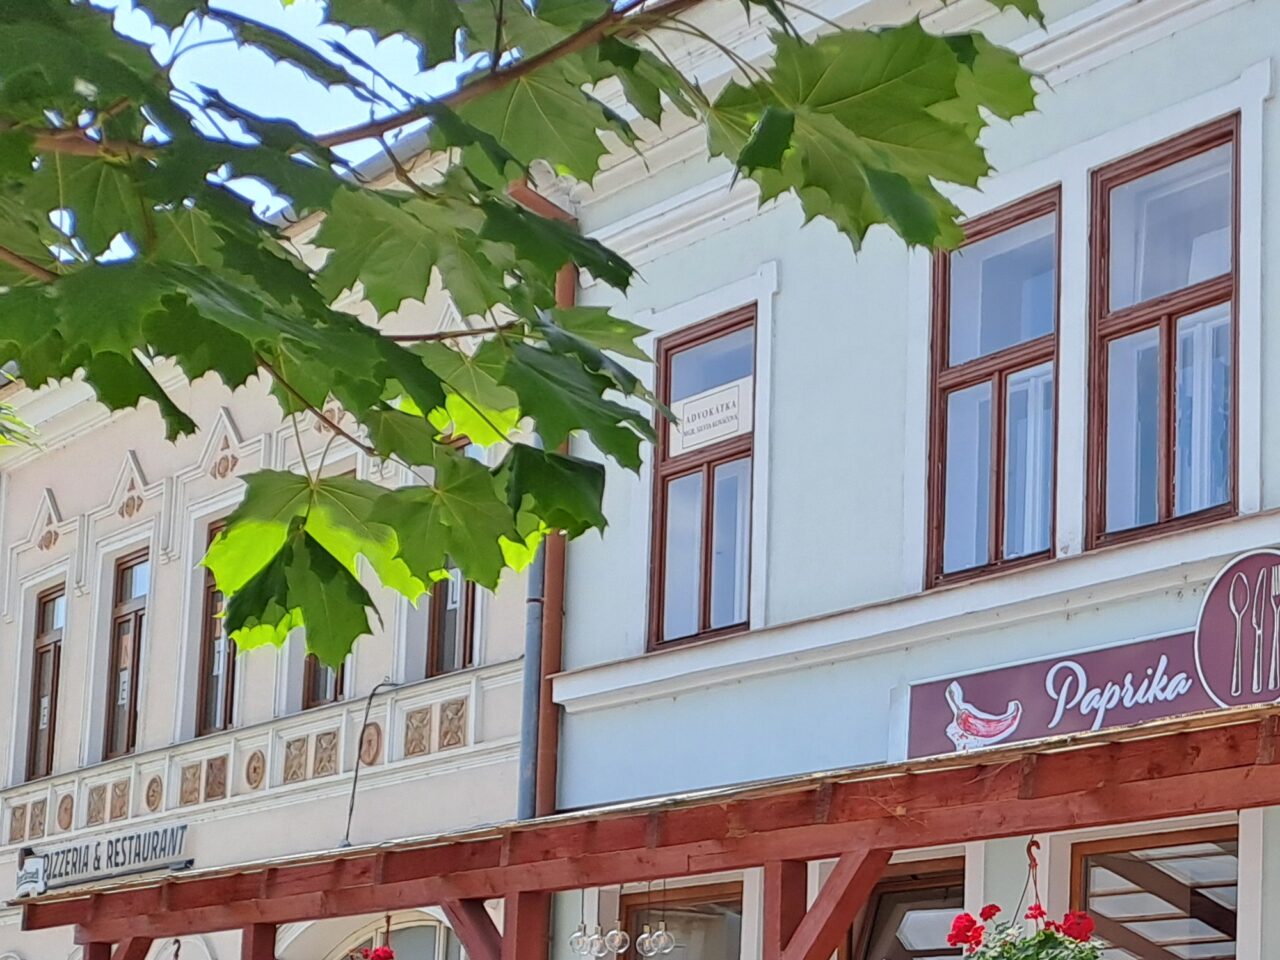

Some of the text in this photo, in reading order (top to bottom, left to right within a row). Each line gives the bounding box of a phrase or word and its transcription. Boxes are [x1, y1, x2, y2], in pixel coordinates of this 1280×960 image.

[1045, 654, 1193, 731] Paprika
[42, 844, 90, 880] PIZZERIA
[93, 841, 101, 871] &
[106, 824, 188, 869] RESTAURANT
